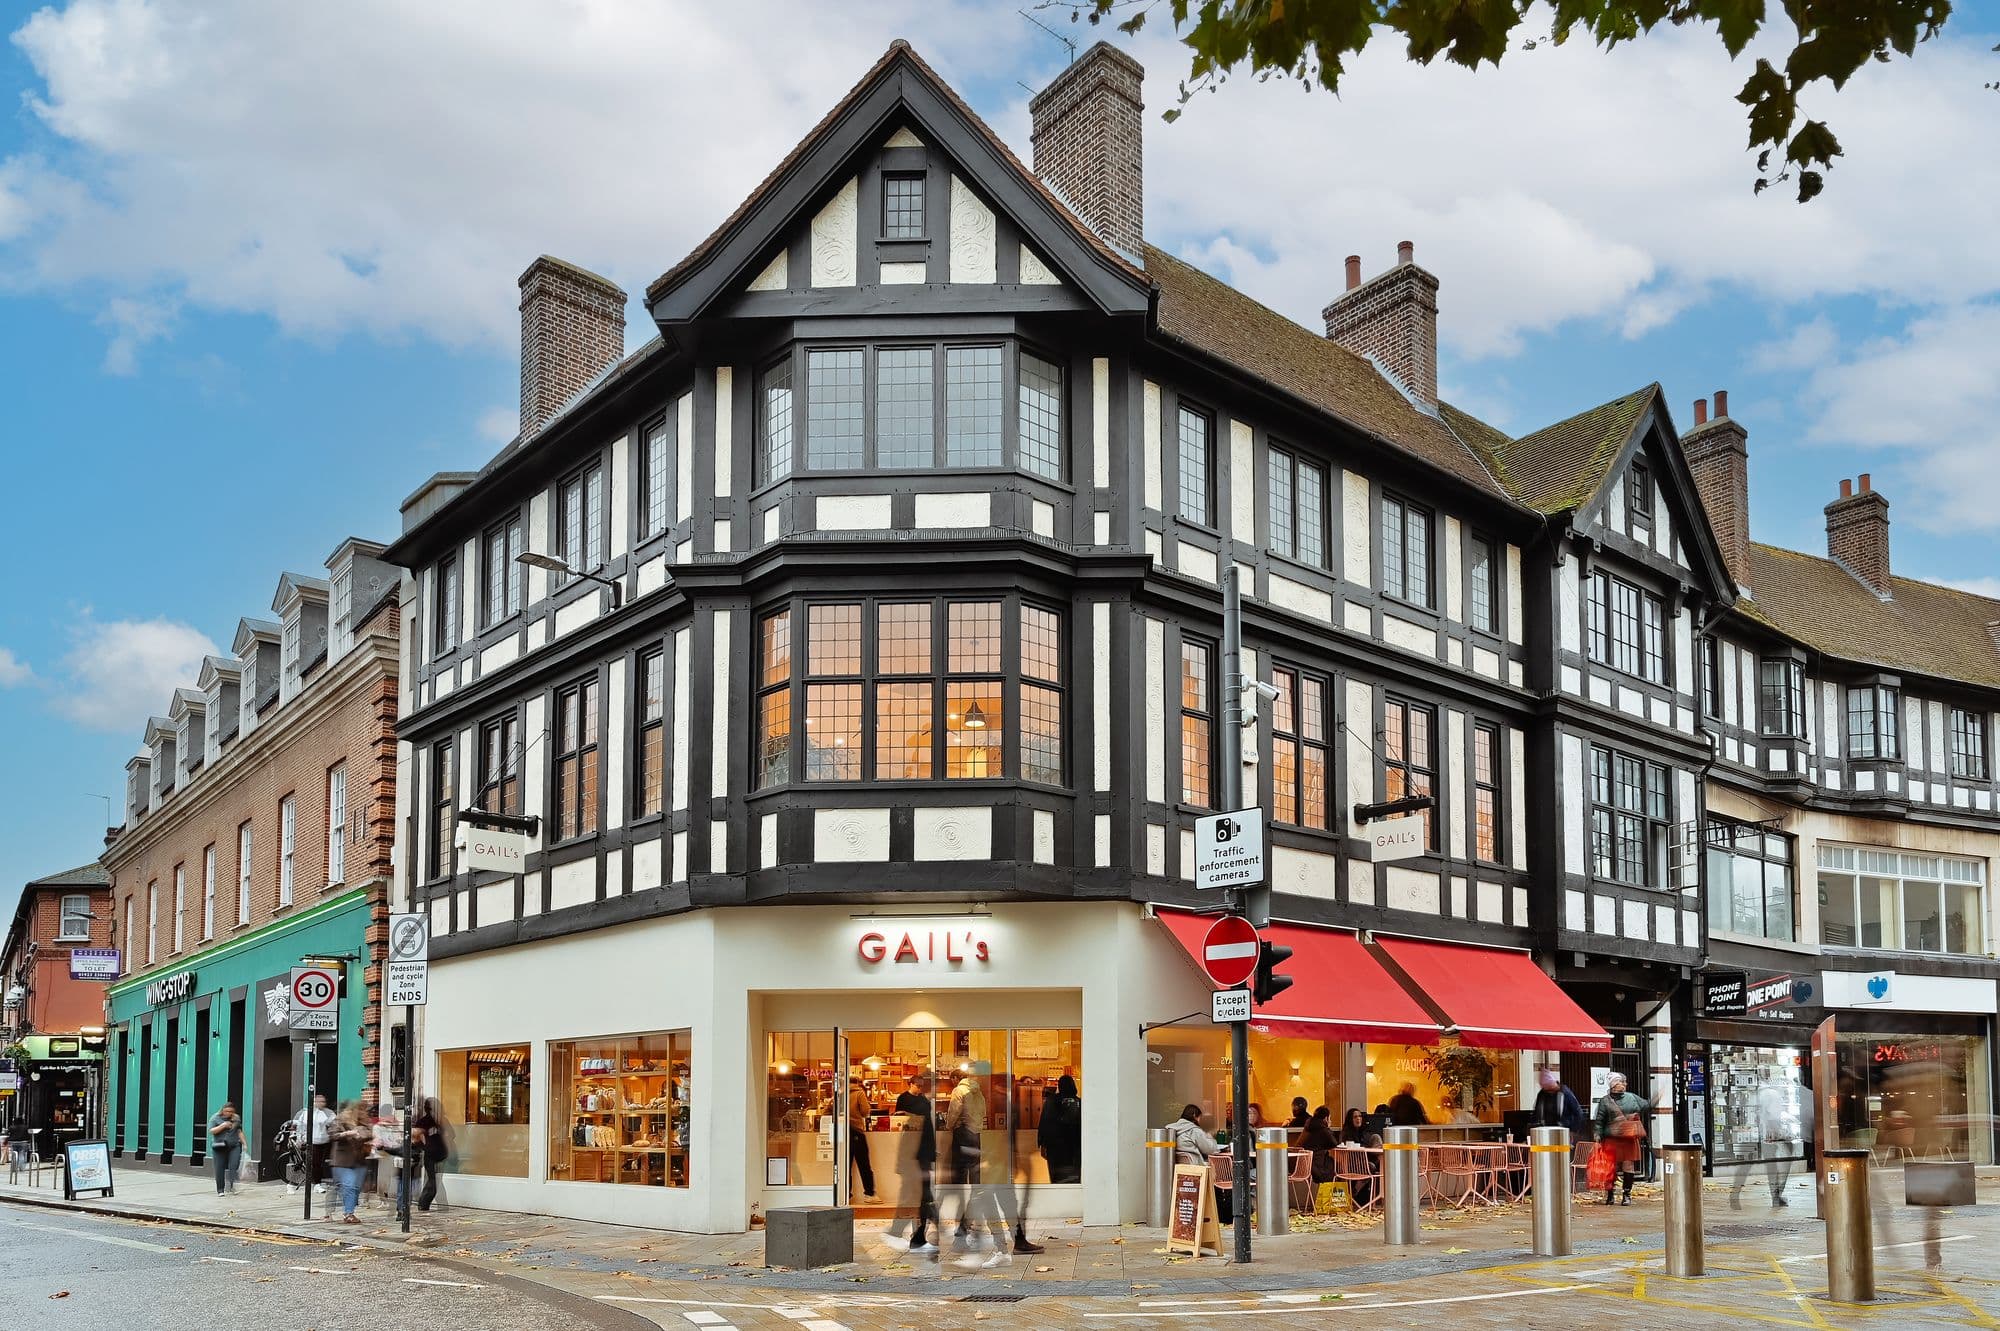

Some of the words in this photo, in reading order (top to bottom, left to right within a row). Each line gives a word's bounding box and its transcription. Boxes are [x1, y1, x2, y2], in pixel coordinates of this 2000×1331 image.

[474, 843, 519, 859] GAIL's
[1213, 846, 1245, 858] Traffic
[1199, 856, 1260, 872] enforcement
[1209, 870, 1250, 882] cameras
[858, 931, 989, 963] GAIL's
[390, 964, 425, 972] Pedestrian
[406, 972, 424, 980] cycle
[300, 982, 328, 998] 30
[1708, 982, 1742, 995] PHONE
[1746, 988, 1764, 1007] ONE
[1764, 979, 1792, 1002] POINT
[392, 991, 422, 1001] ENDS
[1216, 995, 1247, 1005] Except
[1710, 991, 1740, 1004] POINT
[1217, 1007, 1246, 1018] cycles
[1759, 1009, 1767, 1018] Buy
[1769, 1010, 1778, 1018] Sell
[1778, 1010, 1794, 1019] Repairs
